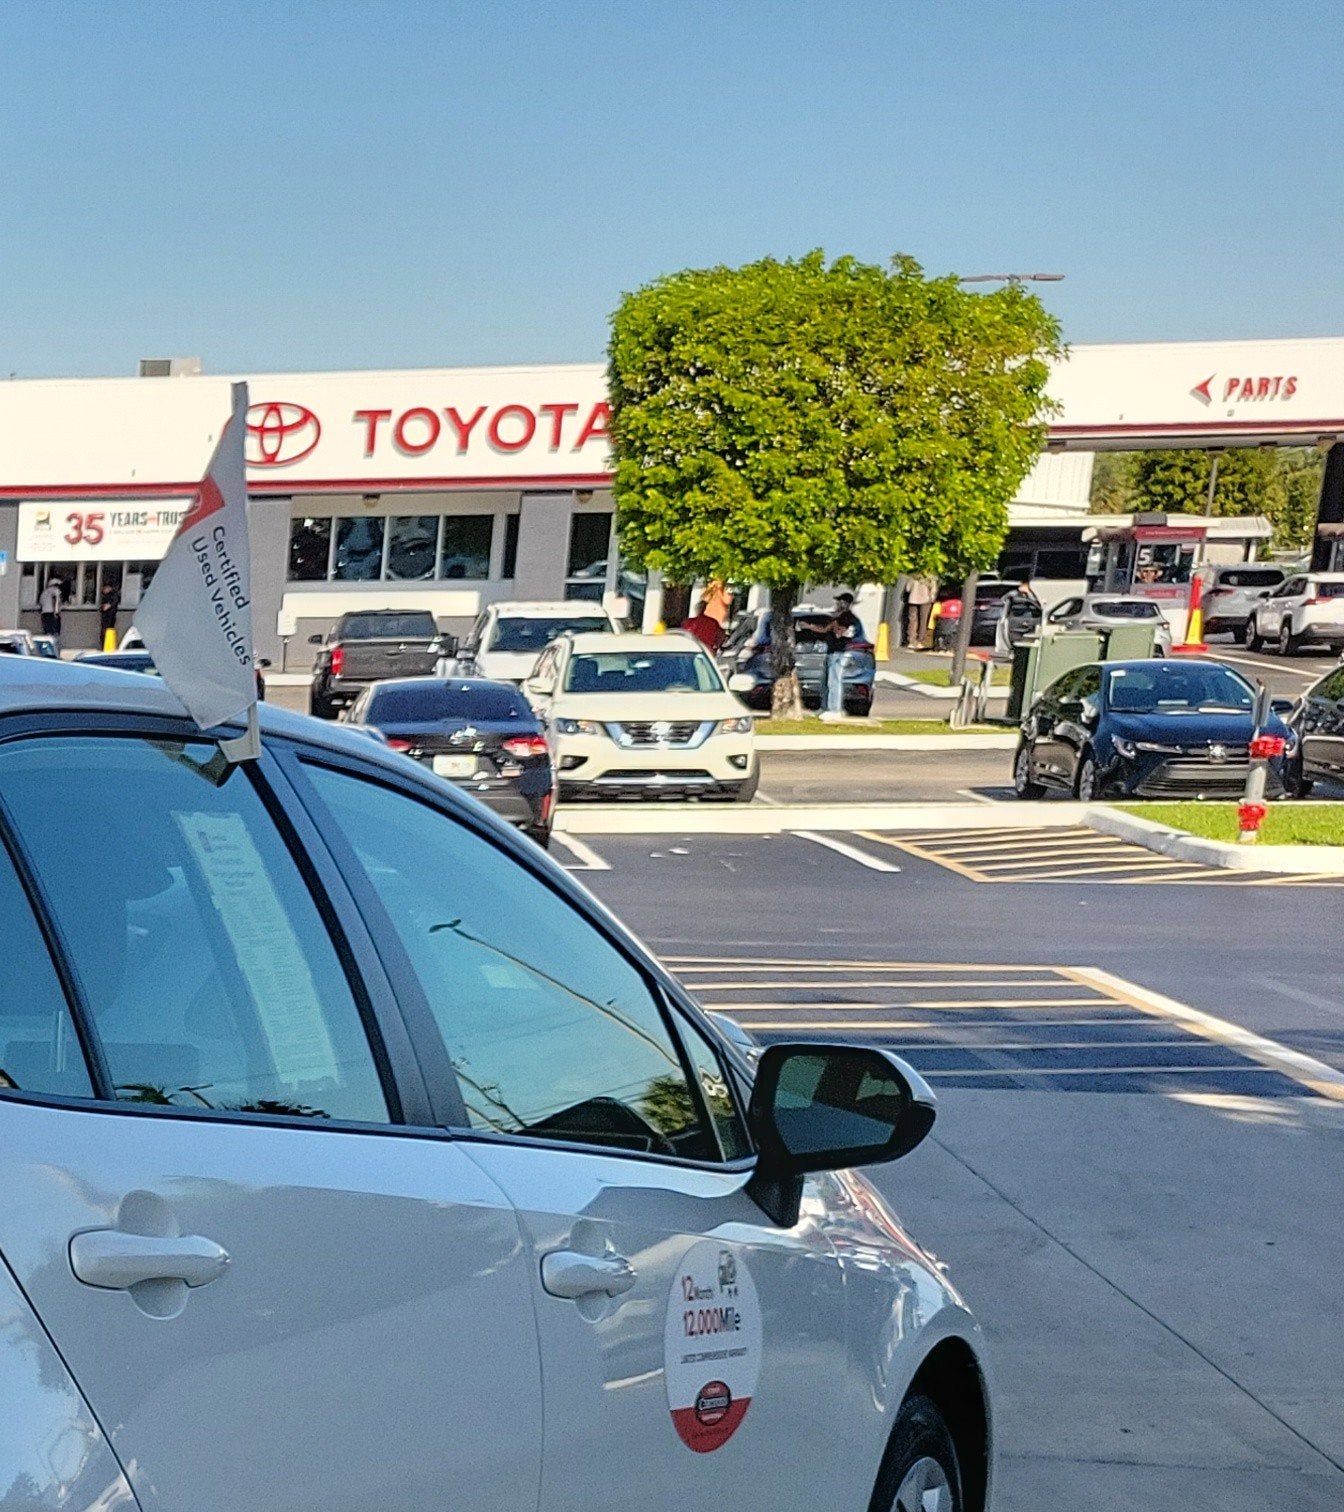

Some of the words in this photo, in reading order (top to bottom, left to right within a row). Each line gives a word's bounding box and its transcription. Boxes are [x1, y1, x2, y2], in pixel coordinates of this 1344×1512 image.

[1223, 375, 1298, 401] PARTS
[64, 511, 105, 545] 35
[110, 511, 148, 528] YEARS
[156, 511, 188, 528] TRUS
[213, 526, 250, 610] Certified
[192, 536, 218, 588] Used
[212, 588, 251, 666] Vehicles
